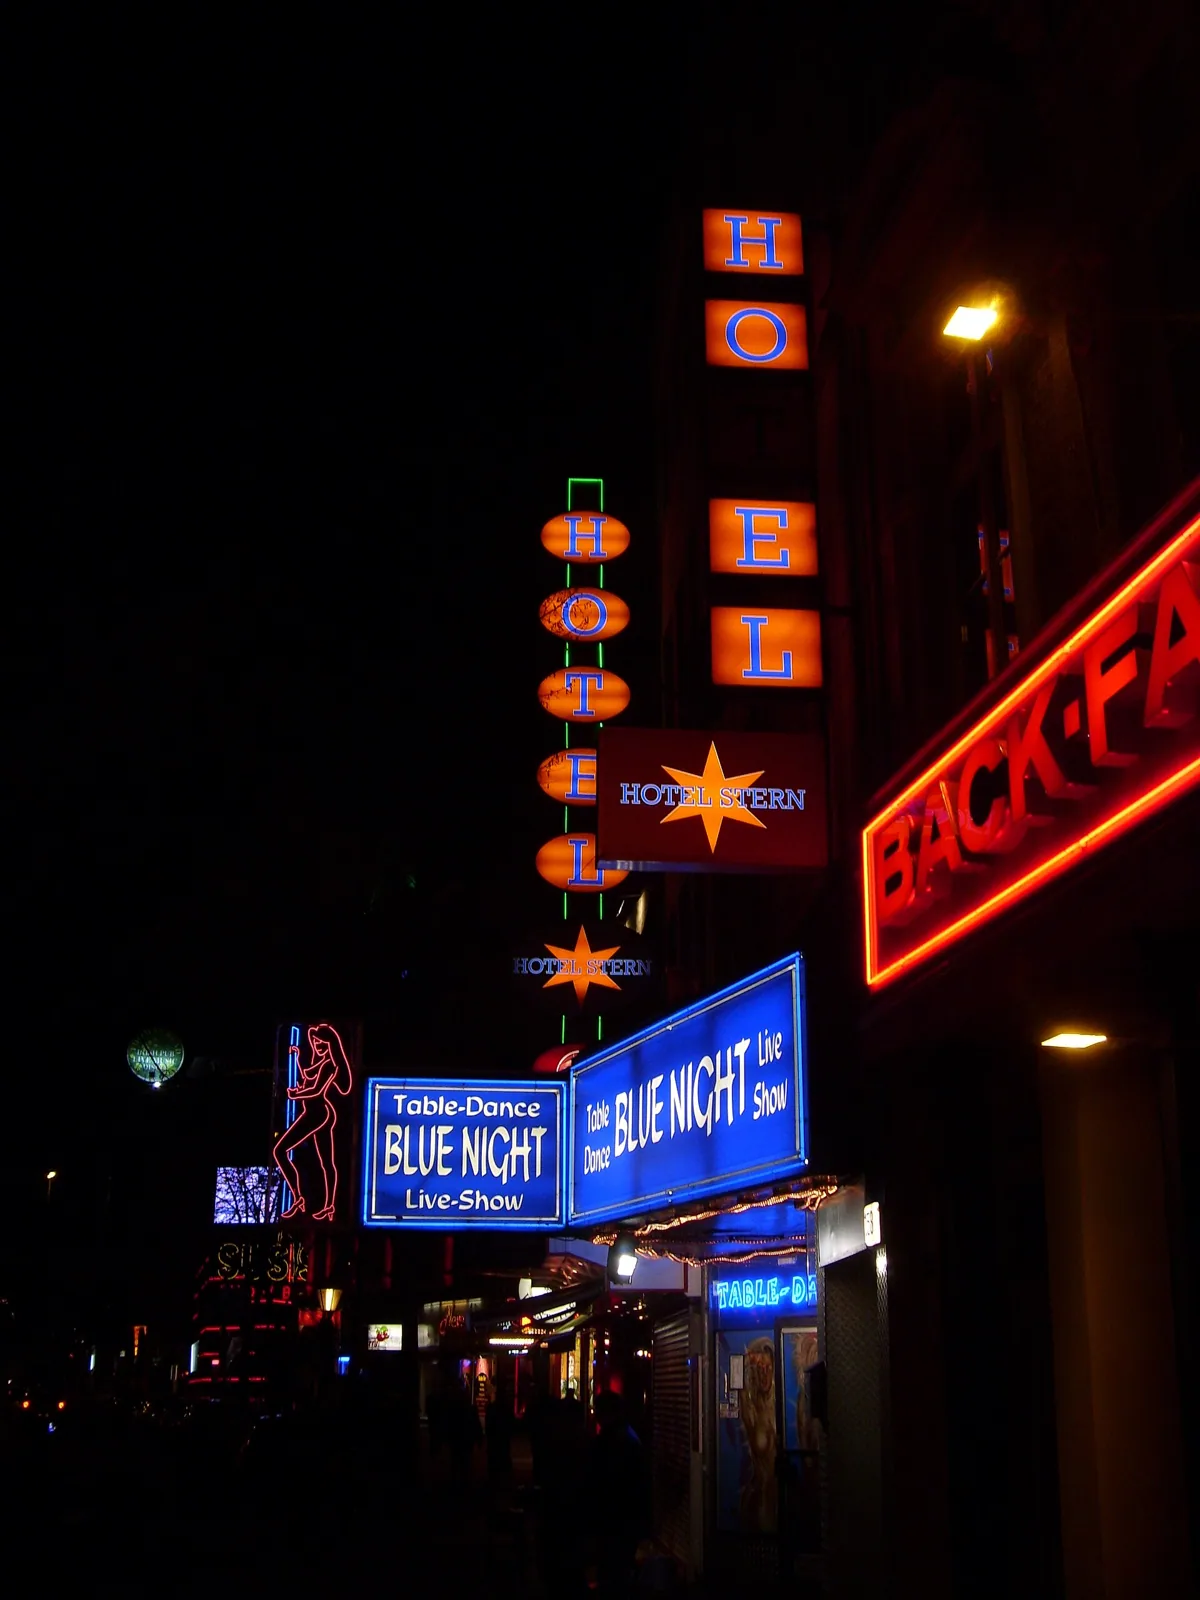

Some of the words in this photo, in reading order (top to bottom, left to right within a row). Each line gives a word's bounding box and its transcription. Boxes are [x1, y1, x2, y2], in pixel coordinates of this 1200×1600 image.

[562, 516, 608, 886] HOTEL
[620, 783, 712, 807] HOTEL
[720, 788, 806, 810] STERN
[513, 957, 582, 975] HOTEL
[587, 959, 652, 976] STERN
[758, 1028, 782, 1067] Live
[393, 1094, 541, 1118] Table-Dance
[614, 1074, 664, 1157] BLUE
[669, 1037, 750, 1136] NIGHT
[753, 1078, 788, 1120] Show
[586, 1099, 610, 1133] Table
[384, 1124, 454, 1176] BLUE
[461, 1126, 548, 1185] NIGHT
[584, 1145, 611, 1175] Dance
[406, 1189, 524, 1211] Live-Show
